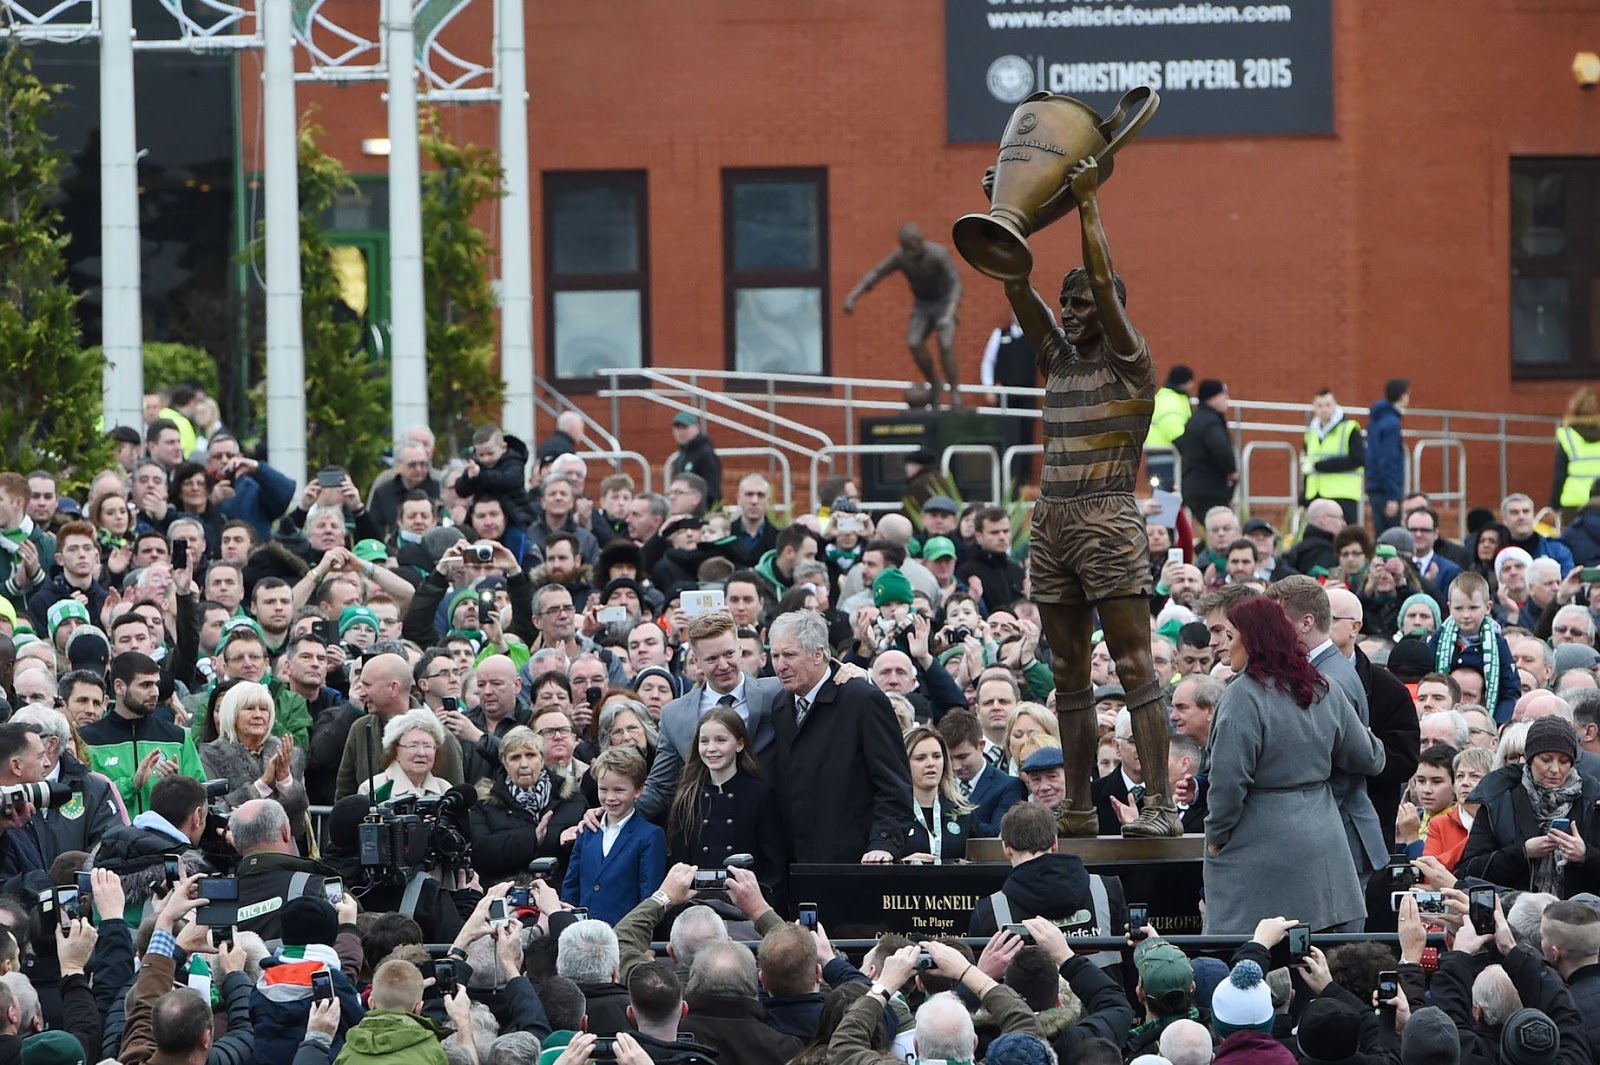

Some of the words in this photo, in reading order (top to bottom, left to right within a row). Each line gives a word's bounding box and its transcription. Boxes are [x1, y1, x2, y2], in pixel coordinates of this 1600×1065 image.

[986, 4, 1292, 29] www.celticfcfoundation.com
[1049, 61, 1162, 93] CHRISTMAS
[1165, 58, 1240, 90] APPEAL
[1243, 57, 1293, 89] 2015
[882, 894, 921, 910] BILLY
[924, 894, 980, 911] McNEIL
[911, 916, 927, 927] The
[928, 916, 954, 929] Player
[1148, 915, 1201, 930] EUROPE
[1063, 926, 1102, 938] ticfc.tv
